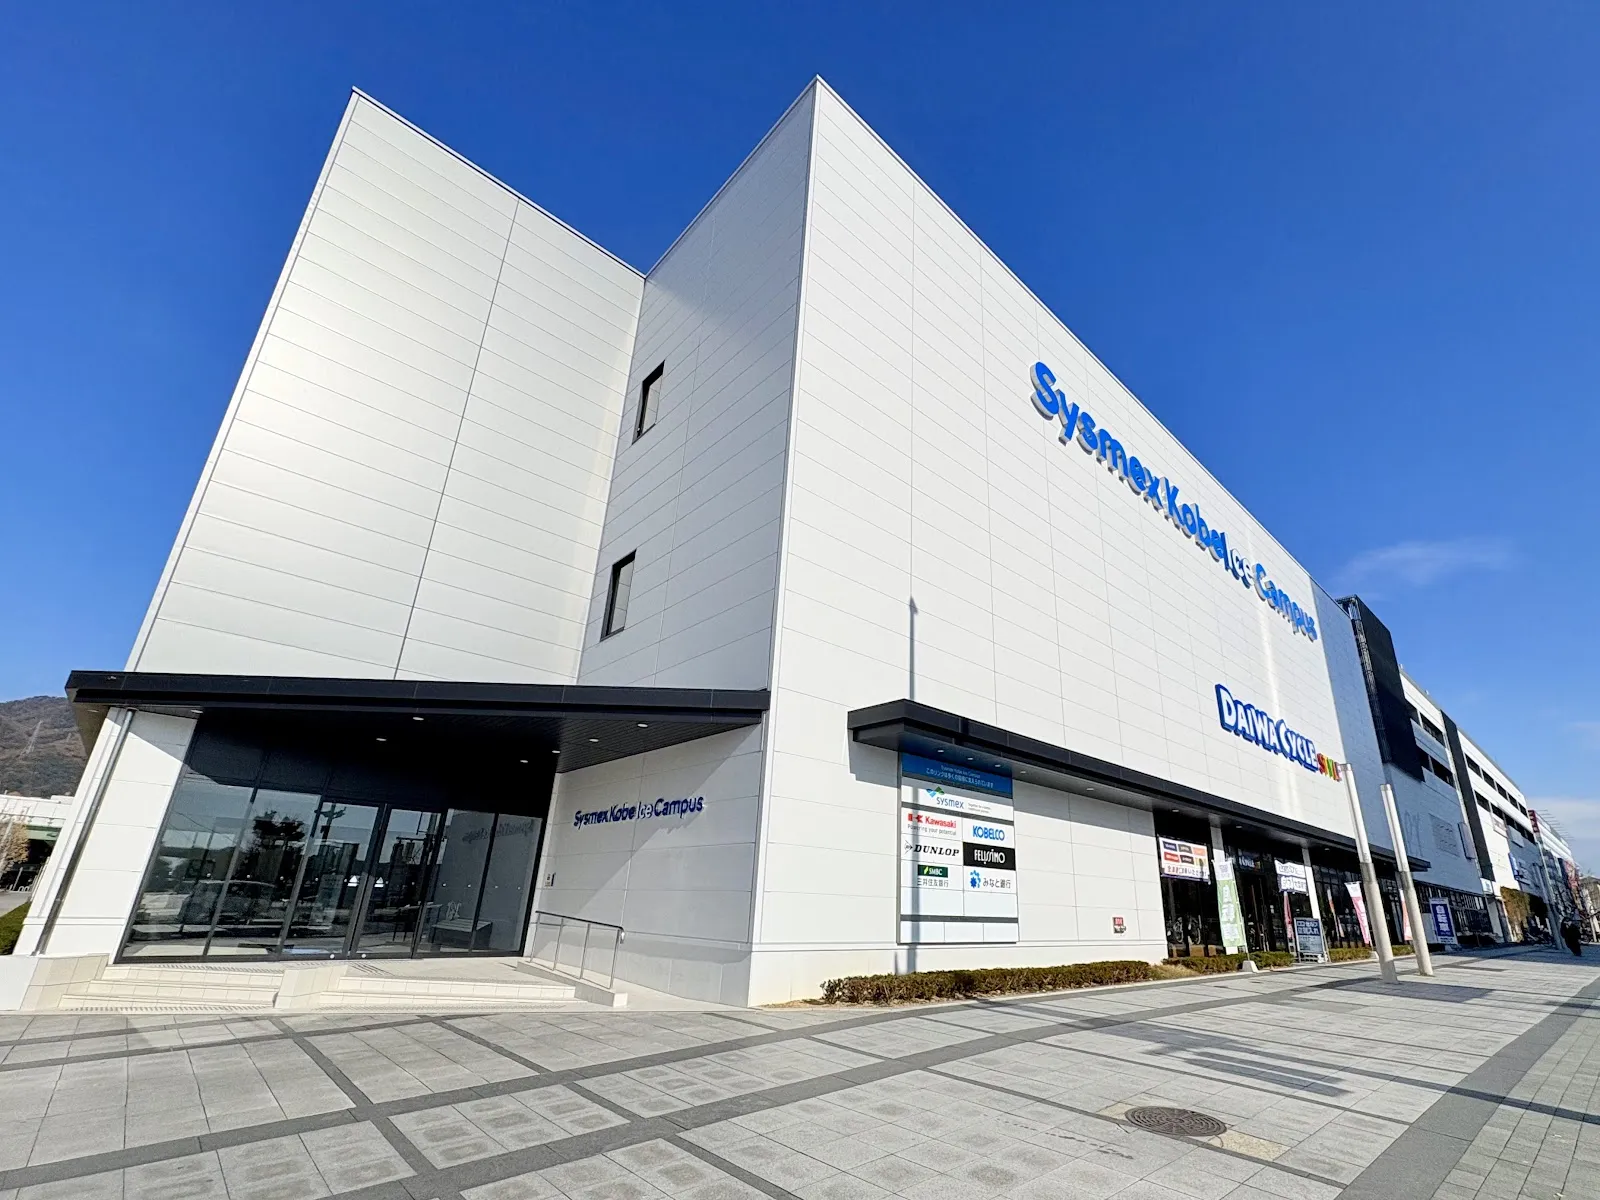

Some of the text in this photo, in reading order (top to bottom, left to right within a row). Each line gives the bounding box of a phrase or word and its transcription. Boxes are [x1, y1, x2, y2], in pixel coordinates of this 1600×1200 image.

[1030, 362, 1318, 643] Sysmex Kobe Ice Campus
[936, 797, 964, 809] sysmex
[574, 797, 704, 830] Sysmex Kobe Ice Campus
[925, 816, 957, 828] Kawasaki
[972, 825, 1005, 841] KOBELCO
[914, 844, 960, 857] DUNLOP
[929, 867, 942, 875] SMBC
[983, 878, 1011, 889] みなと銀行
